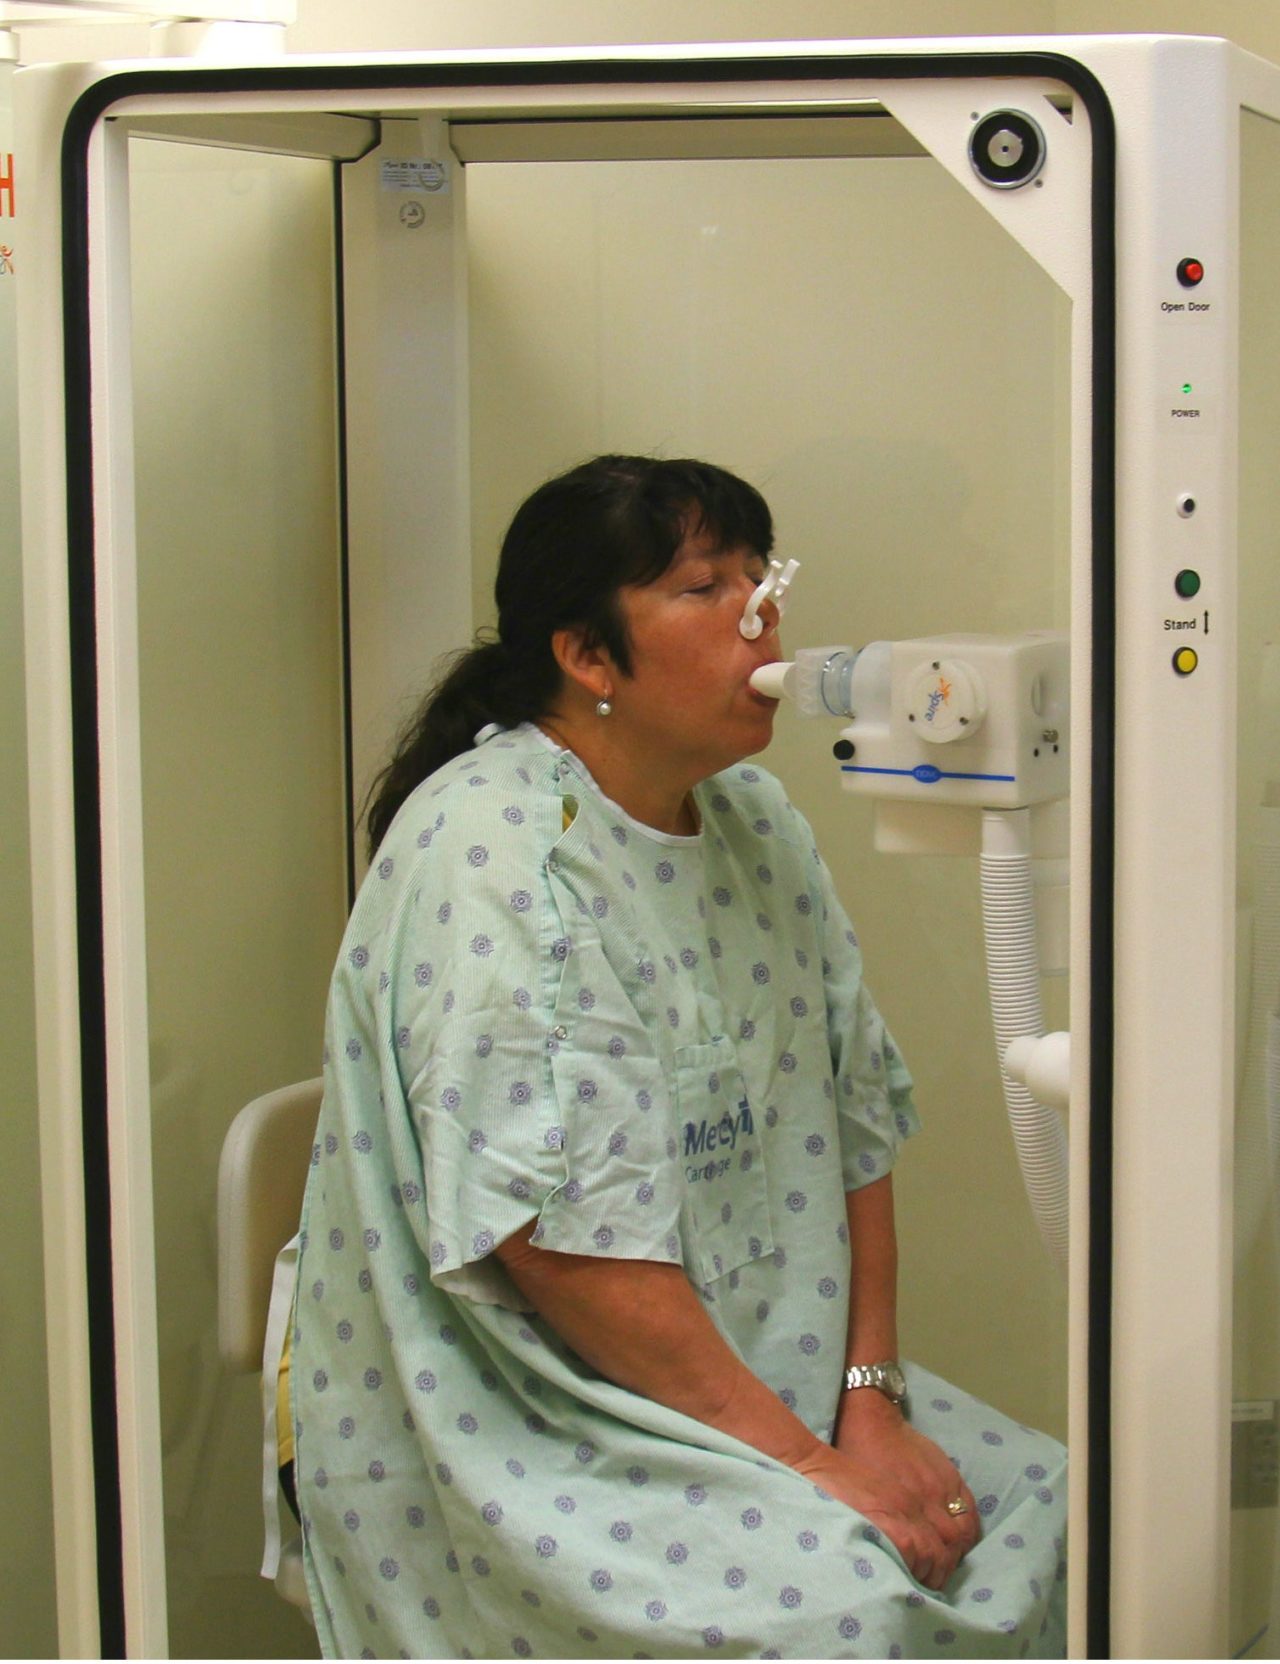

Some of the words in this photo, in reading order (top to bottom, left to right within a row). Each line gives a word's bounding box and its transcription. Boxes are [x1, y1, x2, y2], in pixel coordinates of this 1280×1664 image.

[1161, 302, 1185, 313] Open
[1188, 302, 1210, 311] Door
[1171, 409, 1200, 417] POWER
[1163, 618, 1197, 631] Stand
